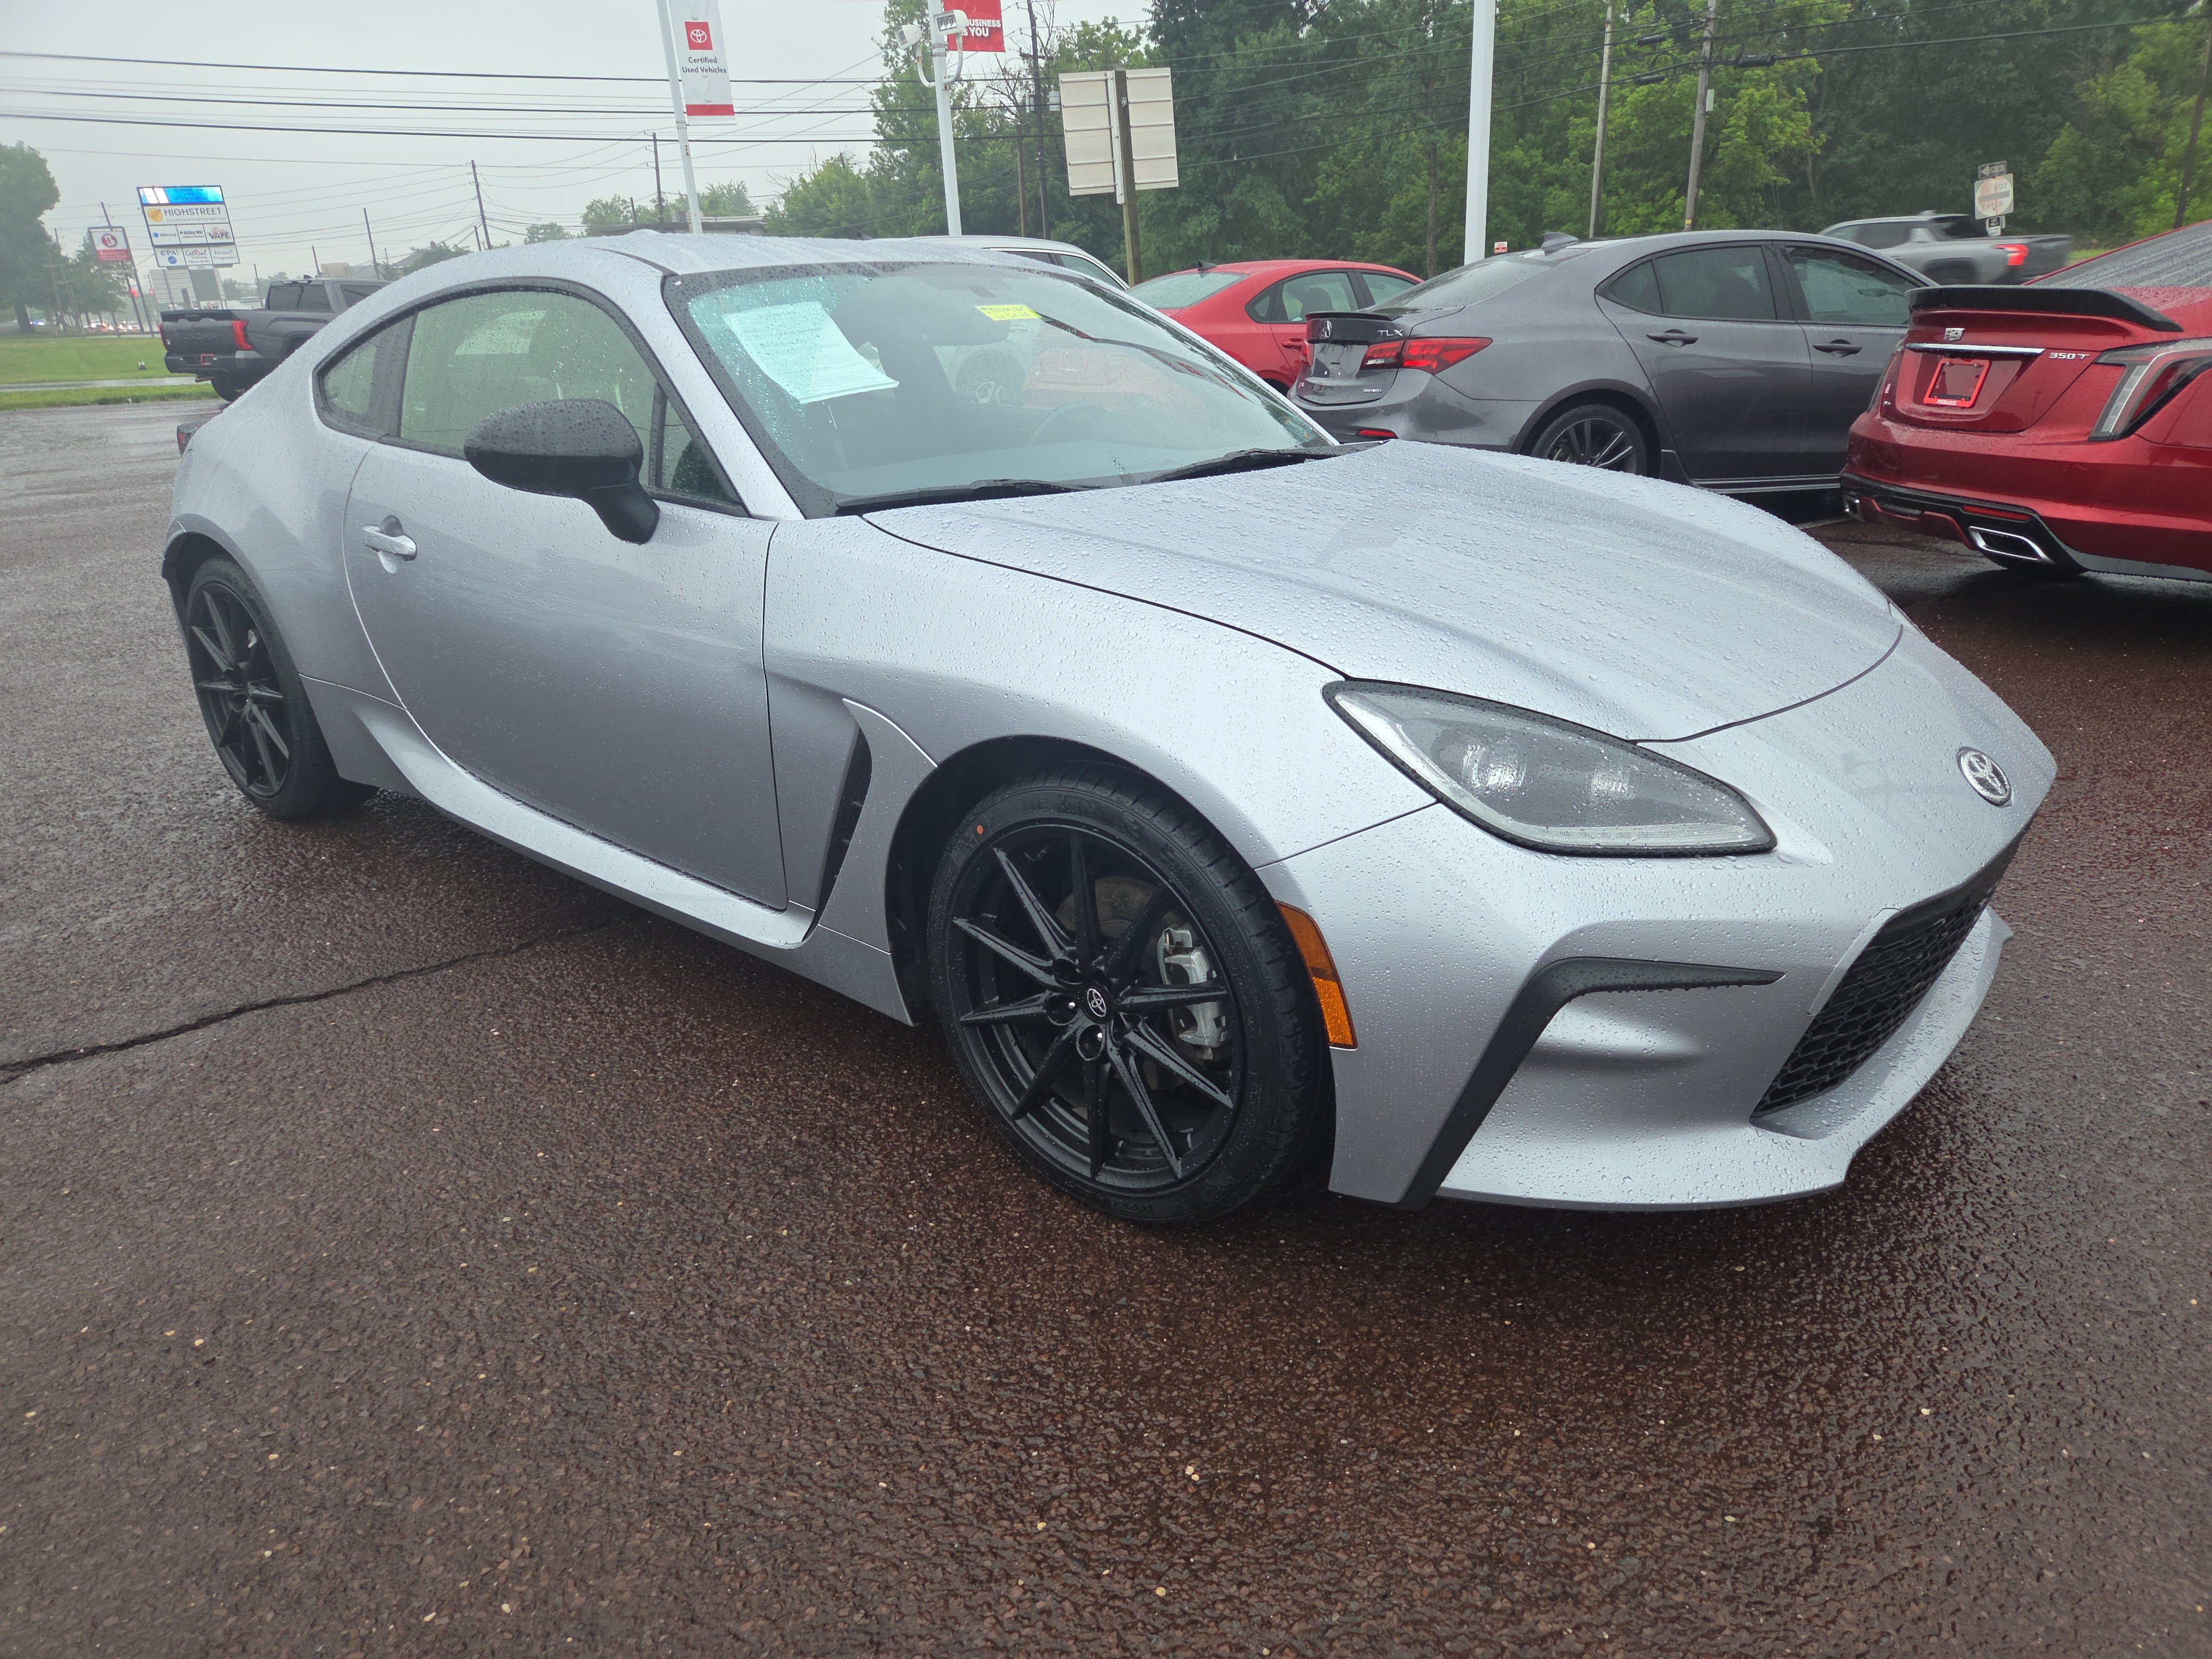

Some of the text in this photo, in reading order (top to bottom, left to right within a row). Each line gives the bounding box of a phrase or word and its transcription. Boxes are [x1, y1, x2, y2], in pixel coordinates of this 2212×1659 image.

[969, 27, 989, 37] YOU
[1981, 201, 2004, 210] ENTER
[164, 207, 222, 216] HIGHSTREET
[207, 231, 231, 240] VAPE
